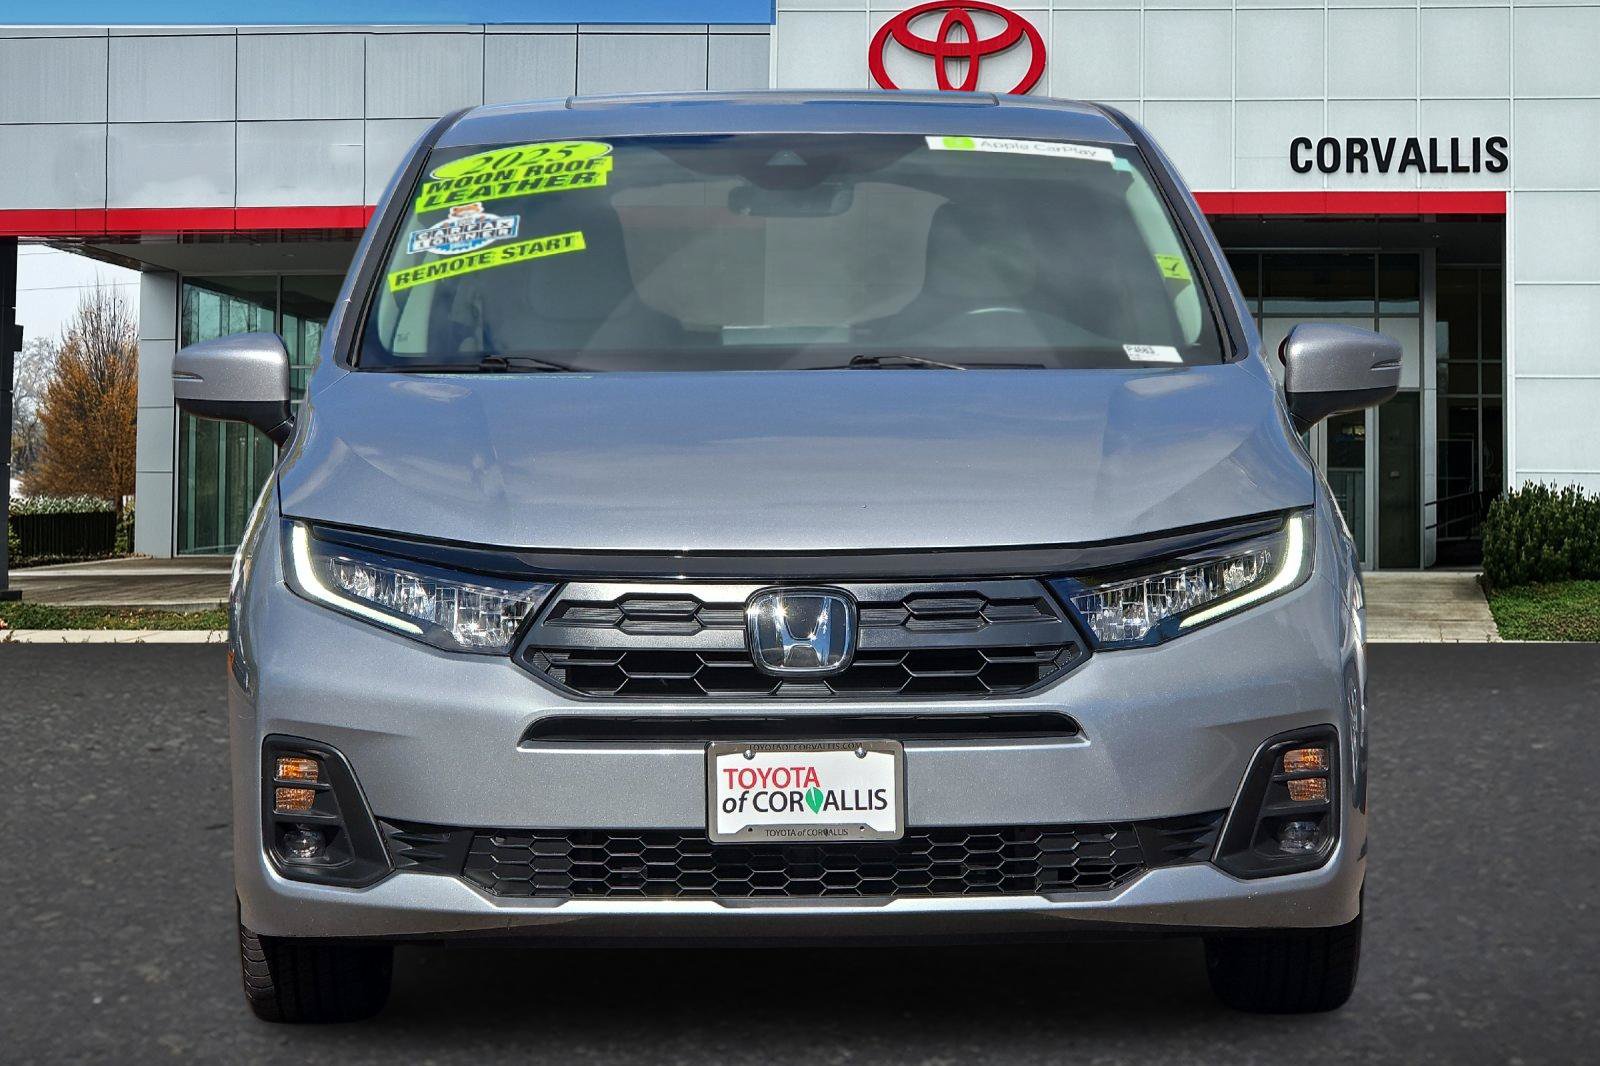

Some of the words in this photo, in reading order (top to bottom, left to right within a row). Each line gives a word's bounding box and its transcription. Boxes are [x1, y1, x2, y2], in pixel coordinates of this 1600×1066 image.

[462, 144, 583, 173] 2025
[980, 140, 1029, 151] Apple
[1033, 143, 1097, 158] CarPlay
[1290, 136, 1509, 174] CORVALLIS
[422, 171, 598, 208] LEATHER
[426, 168, 515, 194] MOON
[523, 157, 606, 177] ROOF
[394, 251, 494, 287] REMOTE
[500, 235, 576, 260] START
[723, 767, 820, 790] TOYOTA
[722, 790, 750, 814] of
[752, 787, 888, 815] CORVALLIS
[765, 829, 796, 837] TOYOTA
[797, 828, 807, 837] of
